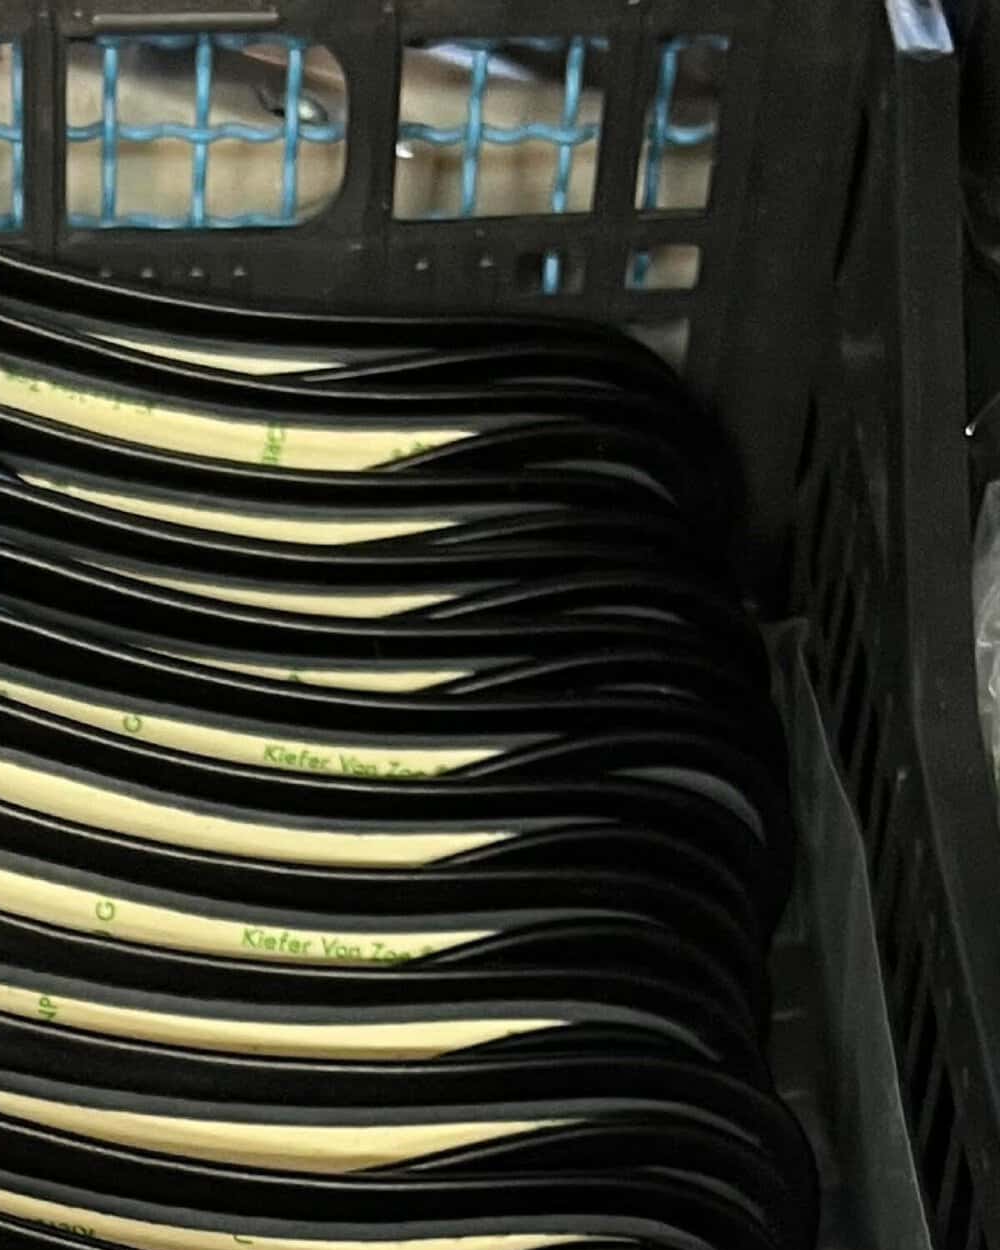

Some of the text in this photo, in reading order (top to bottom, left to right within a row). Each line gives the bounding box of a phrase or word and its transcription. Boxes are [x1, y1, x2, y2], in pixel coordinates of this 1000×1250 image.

[264, 743, 330, 769] Kiefer
[242, 927, 312, 955] Kiefer
[321, 936, 362, 959] Von
